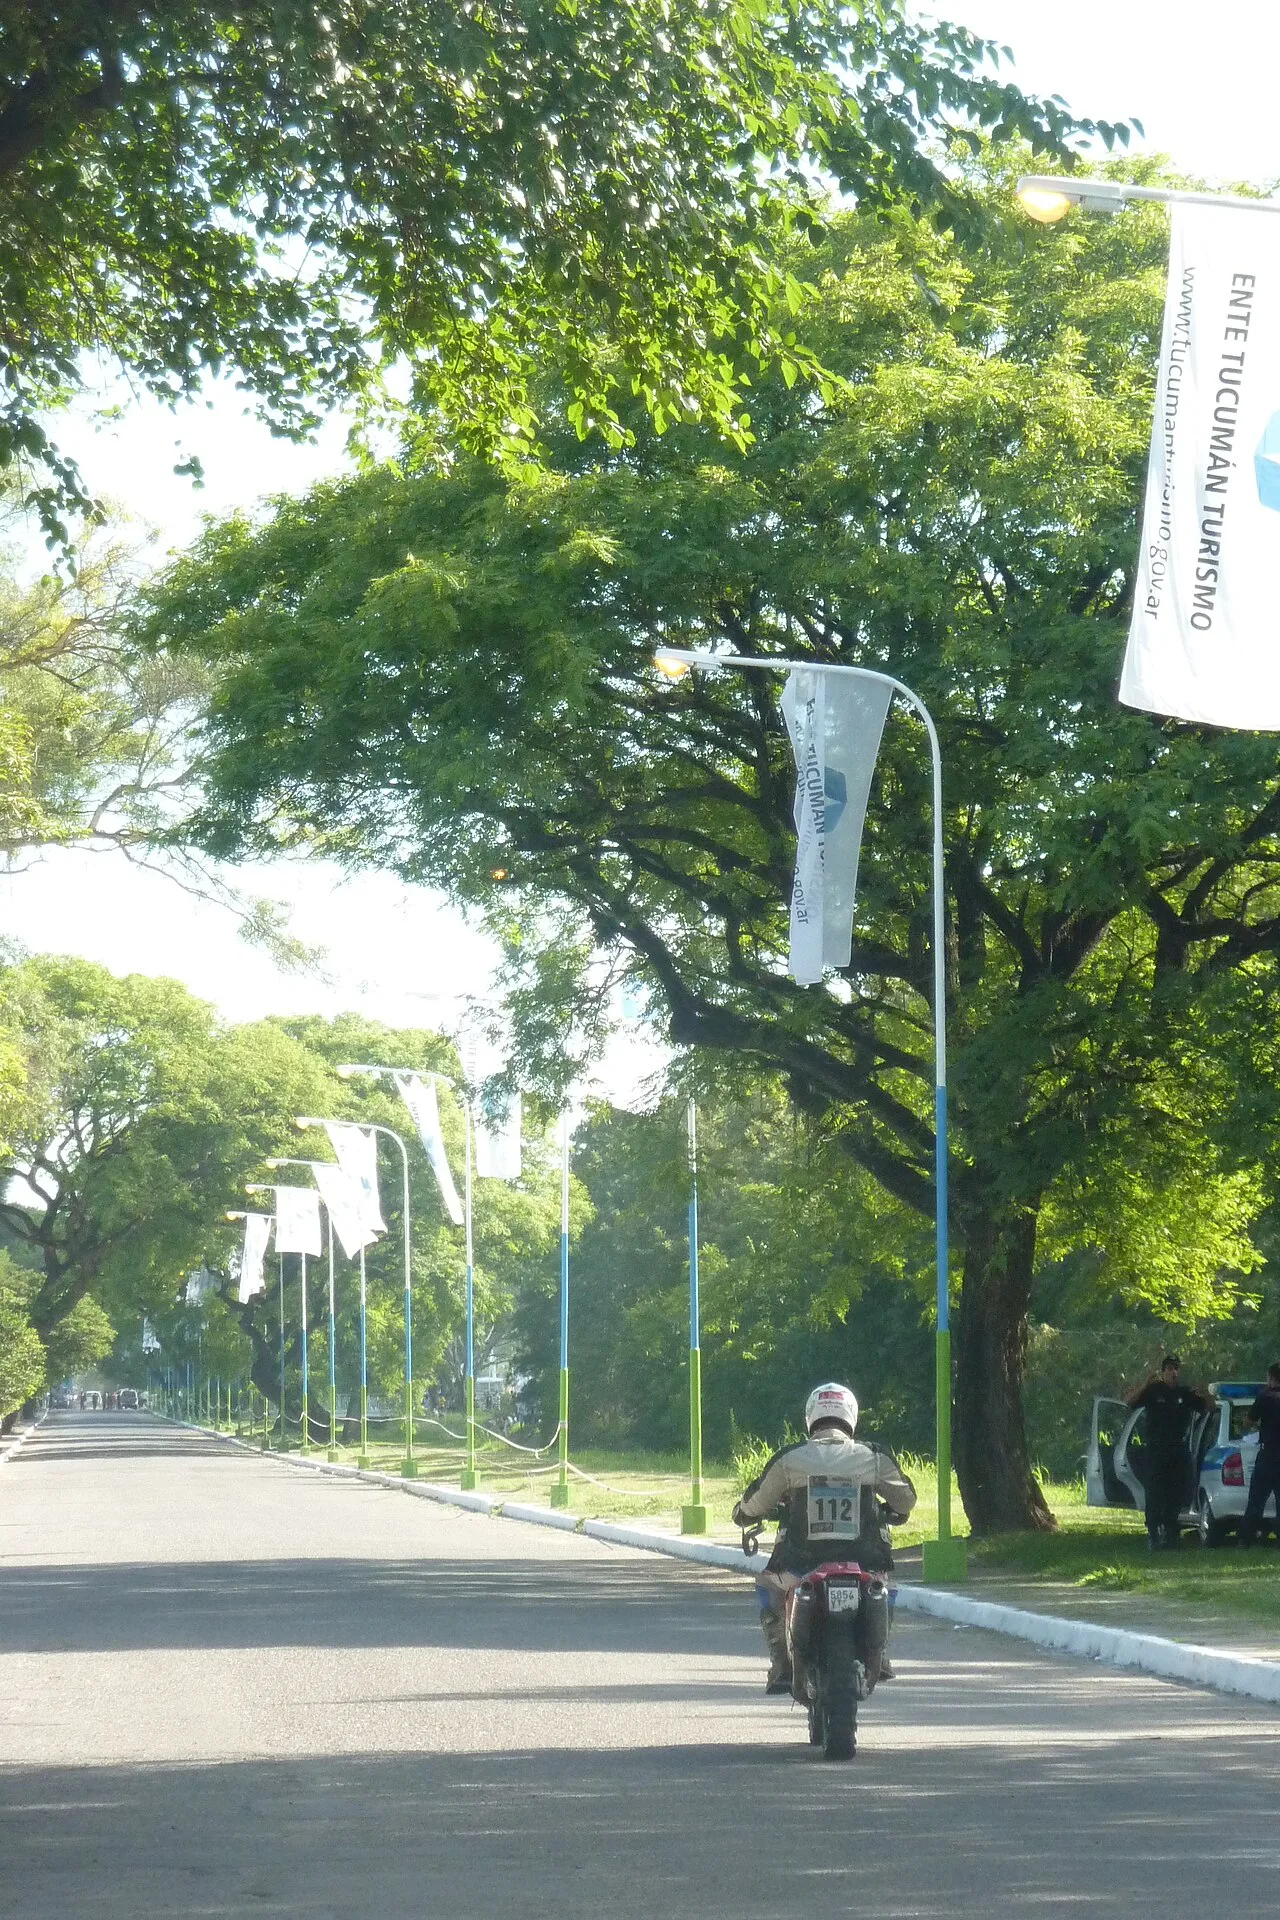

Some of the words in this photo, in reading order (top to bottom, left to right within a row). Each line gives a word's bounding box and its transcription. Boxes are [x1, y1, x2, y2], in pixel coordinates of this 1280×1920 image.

[1224, 272, 1257, 342] ENTE
[1144, 266, 1196, 620] www.tucumantrismo.gov.ar
[1204, 351, 1246, 497] TUCUMÁN
[1190, 501, 1226, 632] TURISMO
[815, 1498, 852, 1521] 112
